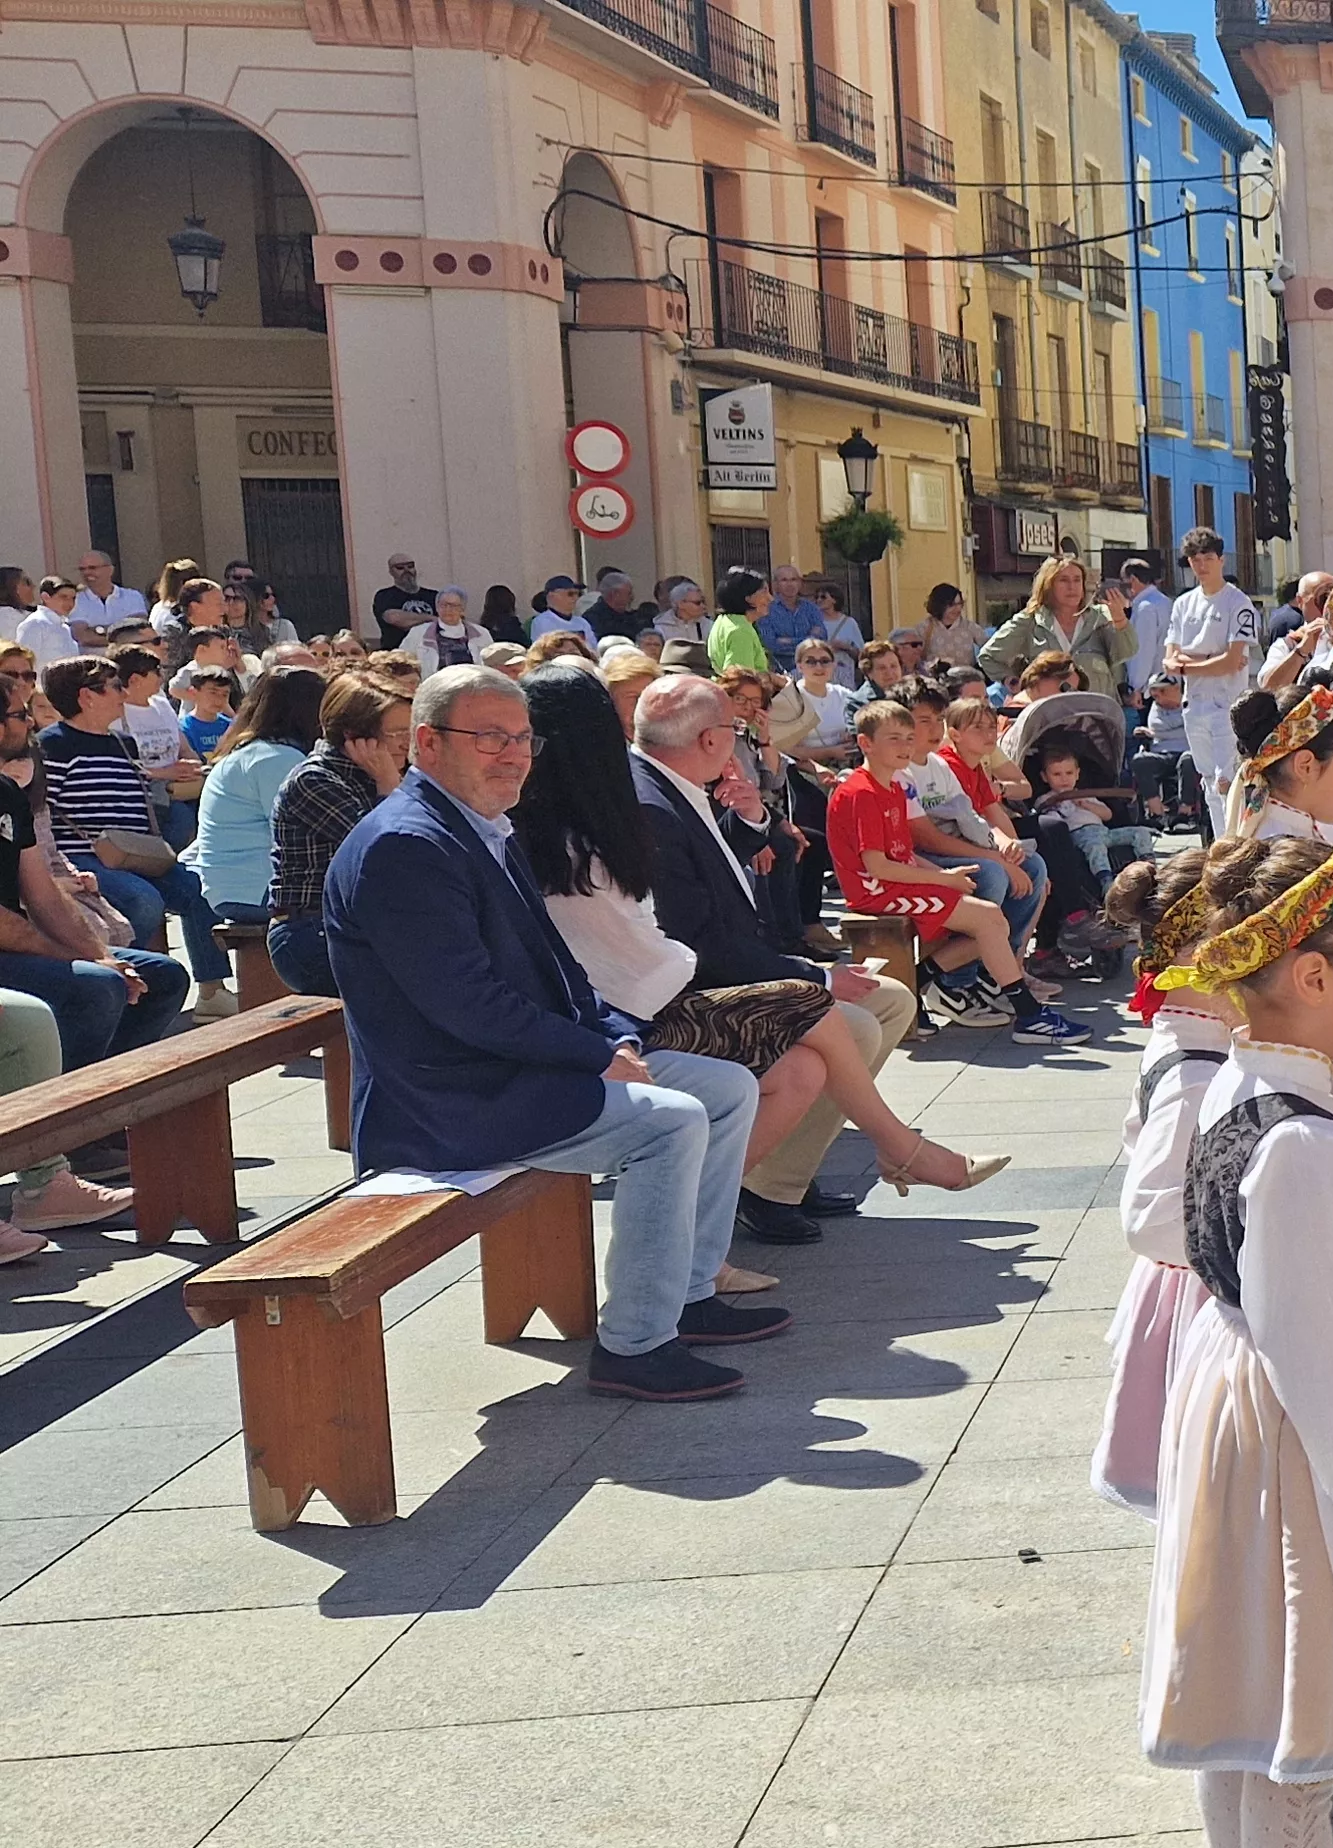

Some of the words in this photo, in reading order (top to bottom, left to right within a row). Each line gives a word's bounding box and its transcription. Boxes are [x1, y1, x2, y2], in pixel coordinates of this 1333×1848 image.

[713, 427, 765, 441] VELTINS
[247, 430, 338, 456] CONFEC
[735, 470, 771, 484] Berlin
